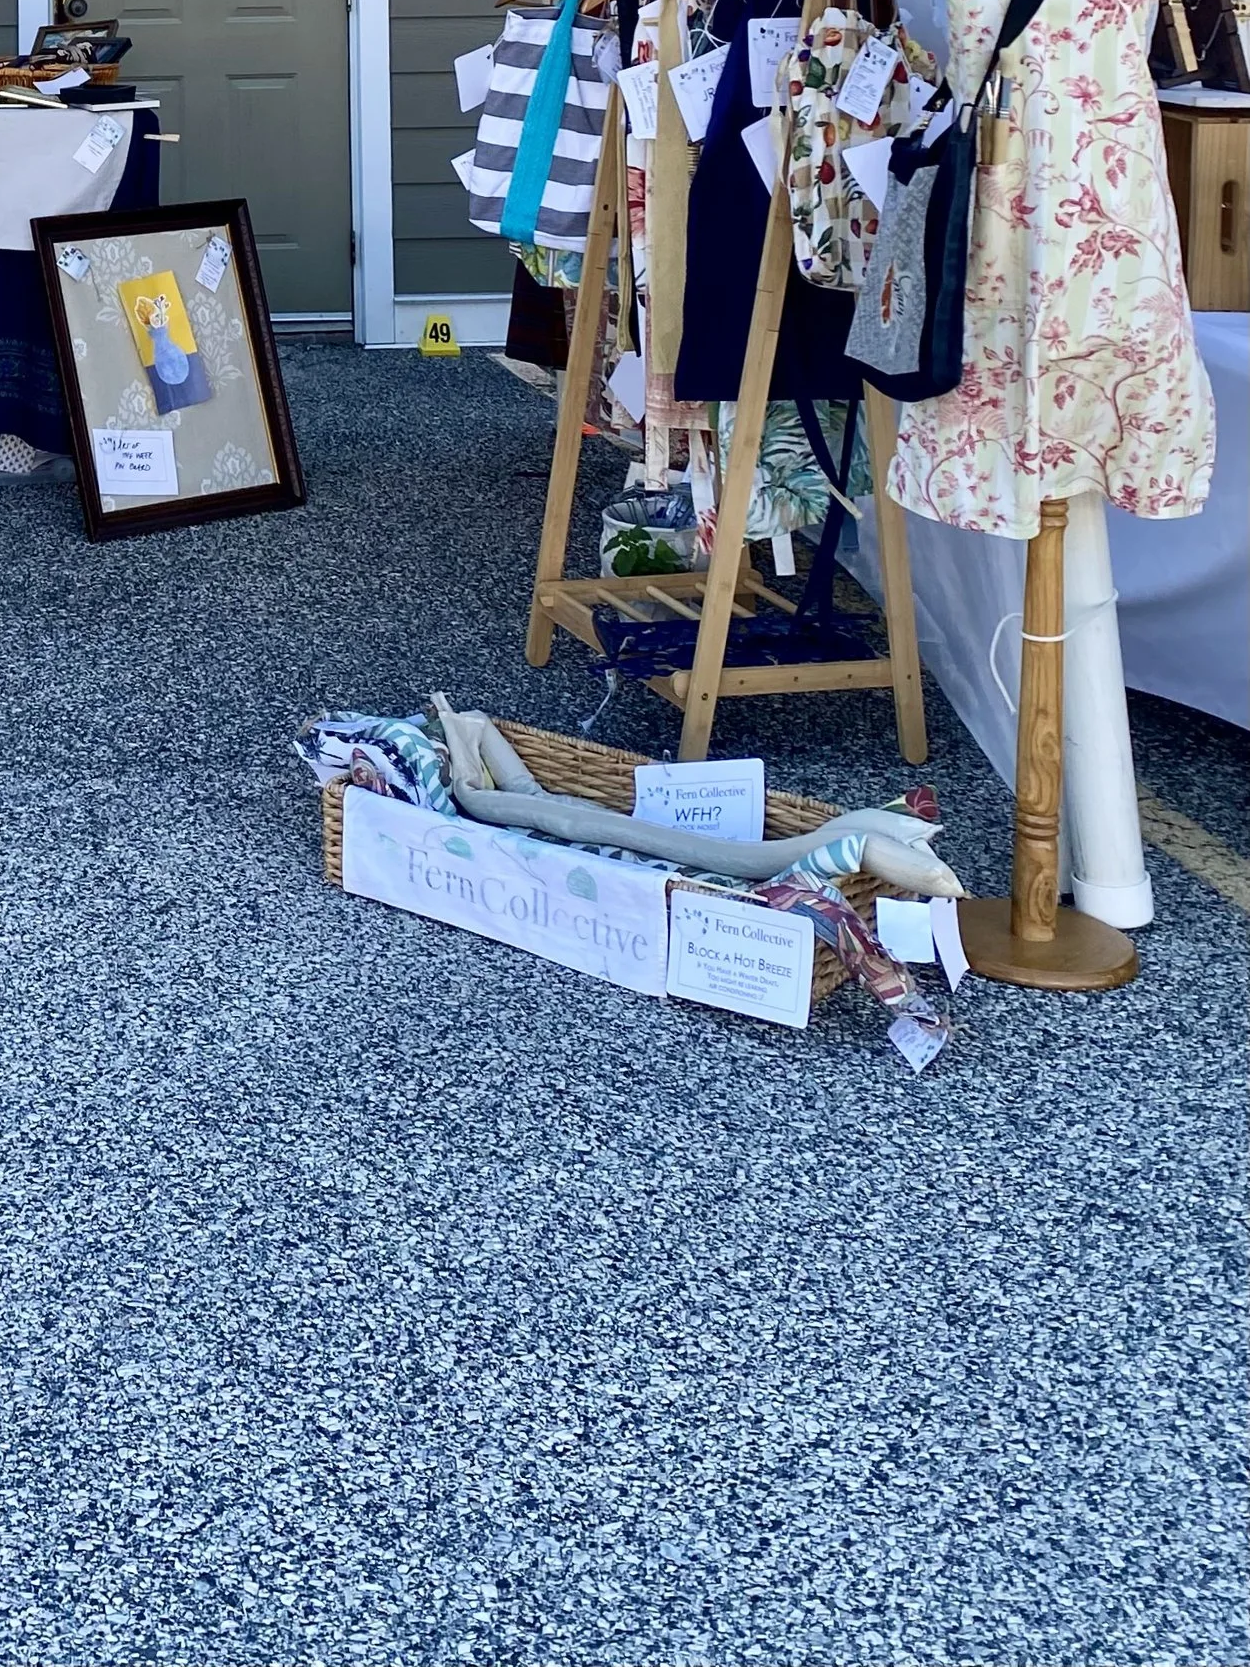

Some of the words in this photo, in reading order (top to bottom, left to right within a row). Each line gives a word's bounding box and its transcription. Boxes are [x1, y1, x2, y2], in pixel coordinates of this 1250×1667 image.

[429, 322, 451, 343] 49
[675, 788, 698, 800] Fern
[699, 786, 746, 799] Collective
[675, 806, 722, 822] WFH?
[406, 845, 476, 904] Fern
[480, 876, 649, 962] Collective
[715, 918, 740, 937] Fern
[741, 924, 794, 949] Collective
[687, 941, 721, 961] BLOCK
[734, 952, 756, 969] HOT
[758, 958, 793, 979] BREEZE
